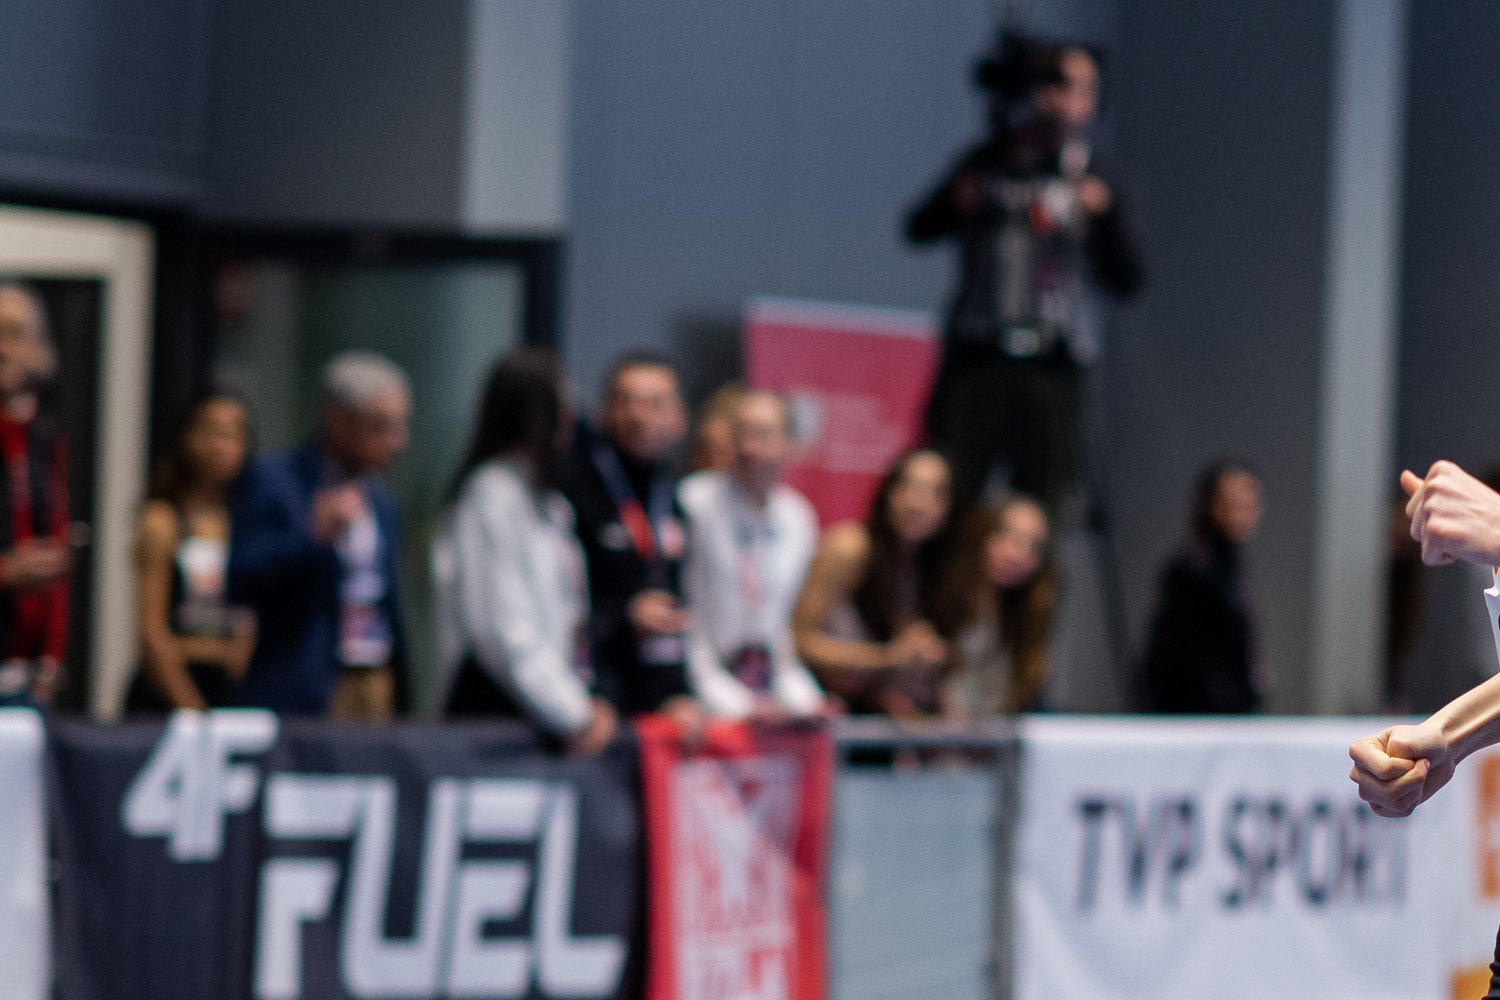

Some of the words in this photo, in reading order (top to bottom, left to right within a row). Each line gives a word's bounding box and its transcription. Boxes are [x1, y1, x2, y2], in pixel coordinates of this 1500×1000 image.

[122, 708, 280, 860] 4F
[1072, 794, 1202, 916] TVP
[1221, 795, 1412, 912] SPORT
